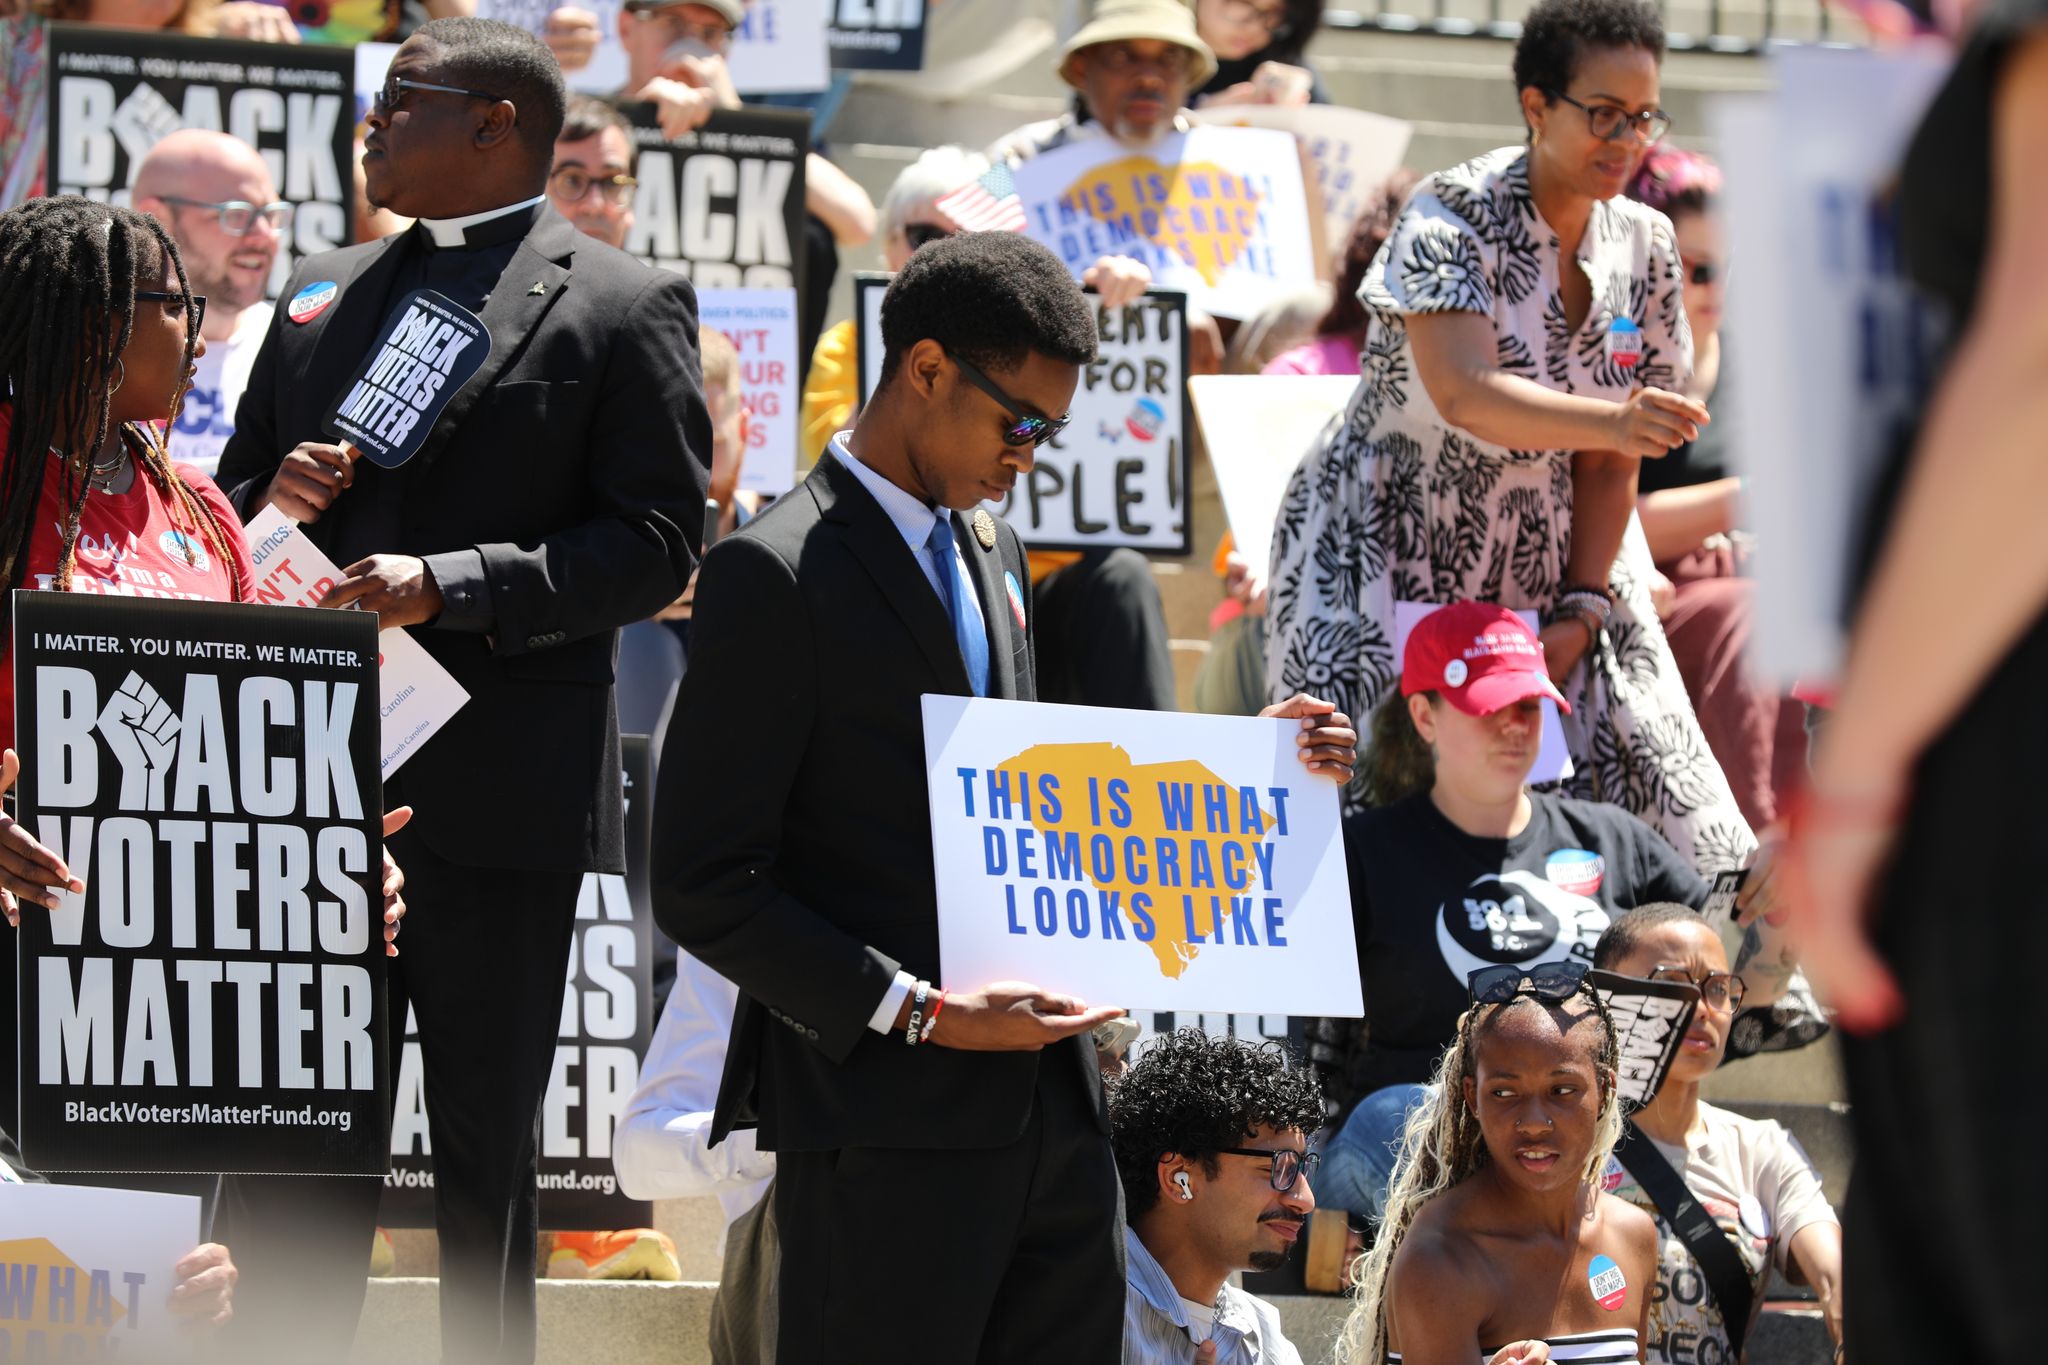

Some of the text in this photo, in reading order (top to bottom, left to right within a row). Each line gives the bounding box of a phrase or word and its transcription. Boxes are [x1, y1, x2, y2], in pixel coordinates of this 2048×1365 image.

[140, 58, 177, 78] YOU
[247, 65, 275, 86] WE
[626, 150, 795, 265] ACK
[1034, 182, 1117, 232] THIS
[1131, 172, 1168, 203] IS
[364, 343, 446, 411] VOTERS
[336, 379, 421, 448] MATTER
[252, 525, 293, 566] OLITICS:
[256, 558, 303, 605] N'T
[34, 633, 363, 668] I MATTER. YOU MATTER. WE MATTER.
[380, 684, 416, 718] Carolina
[387, 742, 406, 762] South
[404, 719, 431, 745] Carolina
[956, 766, 1290, 837] THIS IS WHAT
[37, 814, 370, 956] VOTERS
[982, 825, 1276, 892] DEMOCRACY
[1004, 884, 1289, 948] LOOKS LIKE
[38, 956, 374, 1091] MATTER
[65, 1101, 352, 1132] BlackVotersMatterFund.org
[0, 1262, 147, 1331] WHAT
[1593, 1271, 1610, 1288] DON'T
[1596, 1277, 1625, 1298] OUR MAPS
